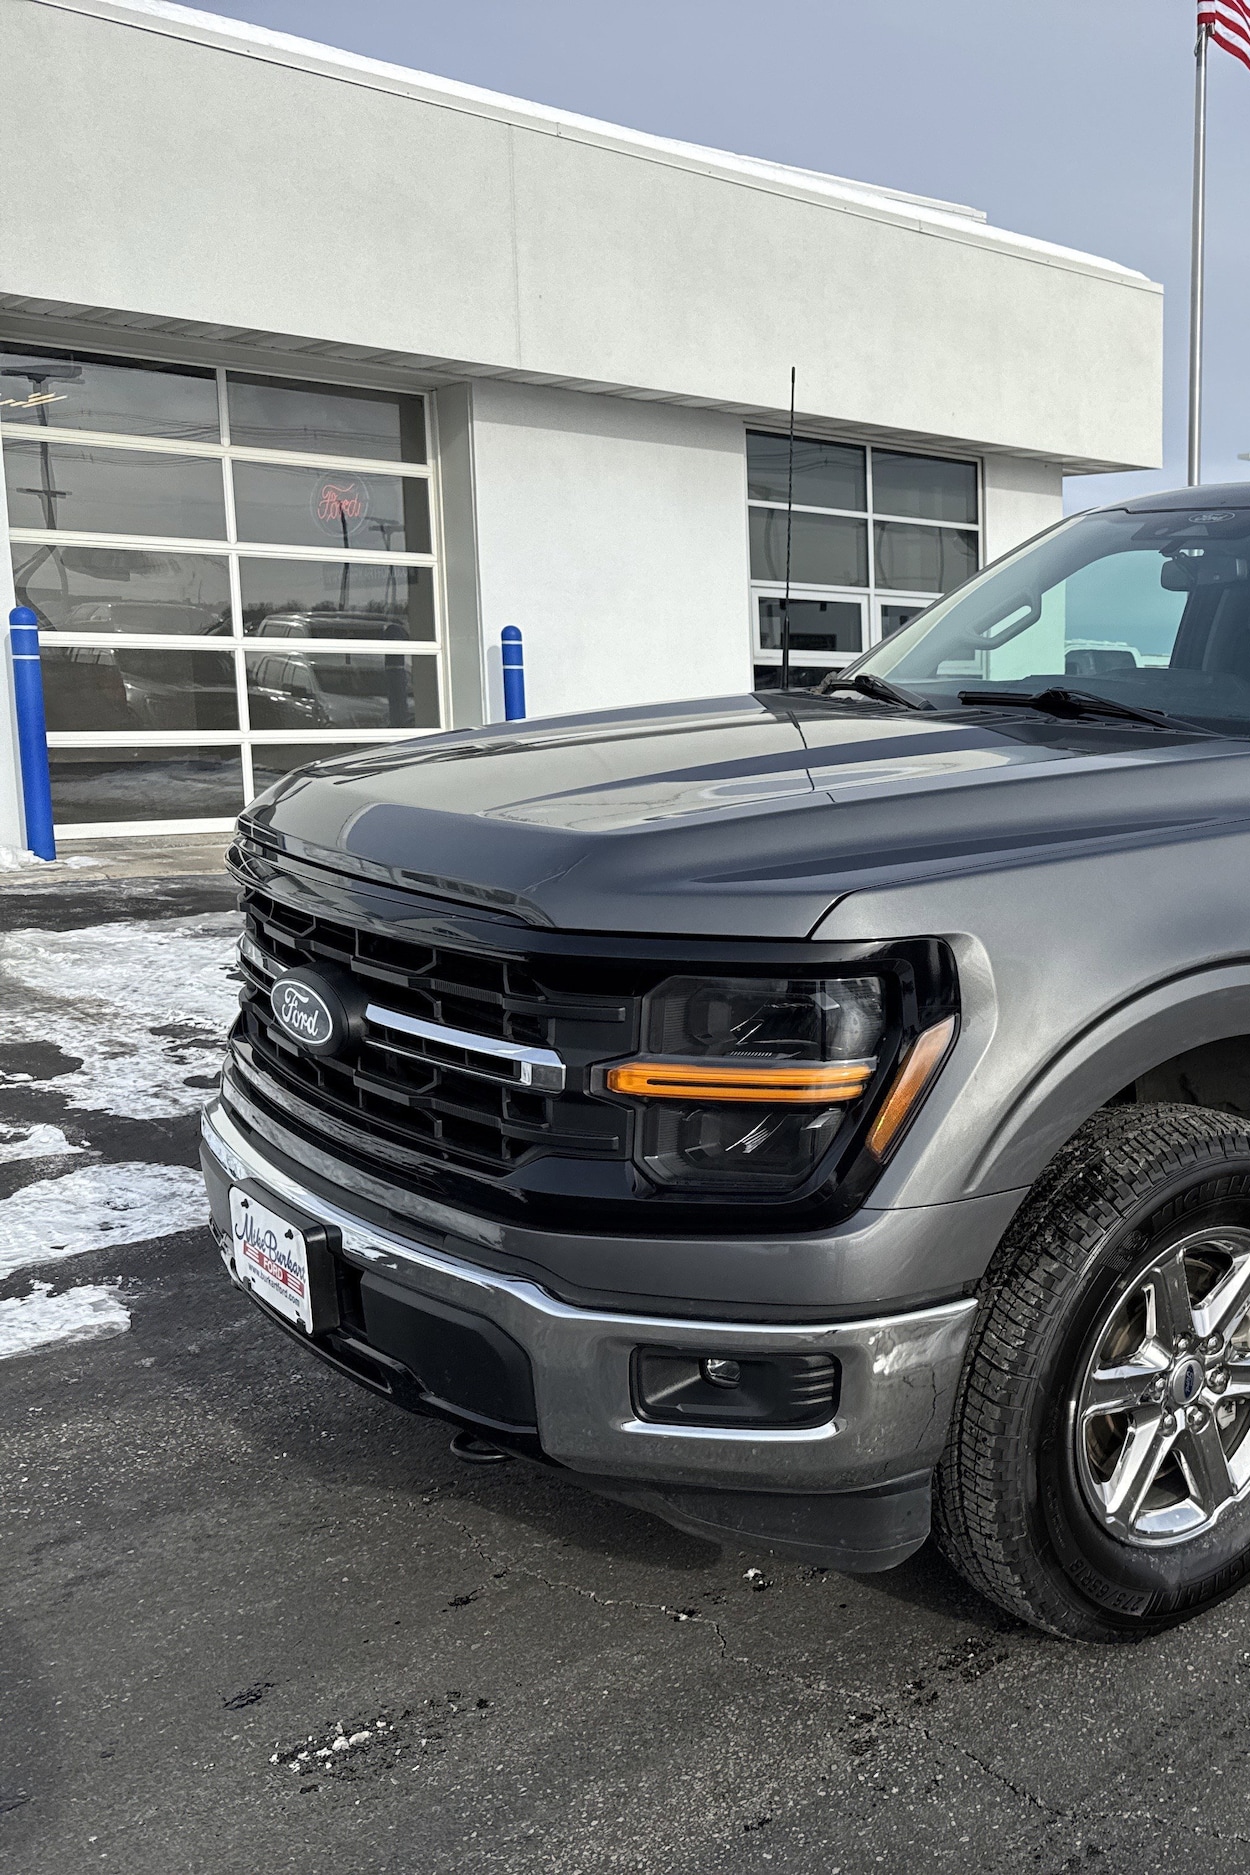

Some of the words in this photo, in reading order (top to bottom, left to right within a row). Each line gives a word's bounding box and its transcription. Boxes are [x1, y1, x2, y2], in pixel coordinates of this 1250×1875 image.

[317, 483, 361, 522] Ford
[281, 987, 319, 1036] Ford
[235, 1213, 266, 1253] Mike
[248, 1263, 300, 1308] www.burkartford.com
[263, 1259, 284, 1281] FORD
